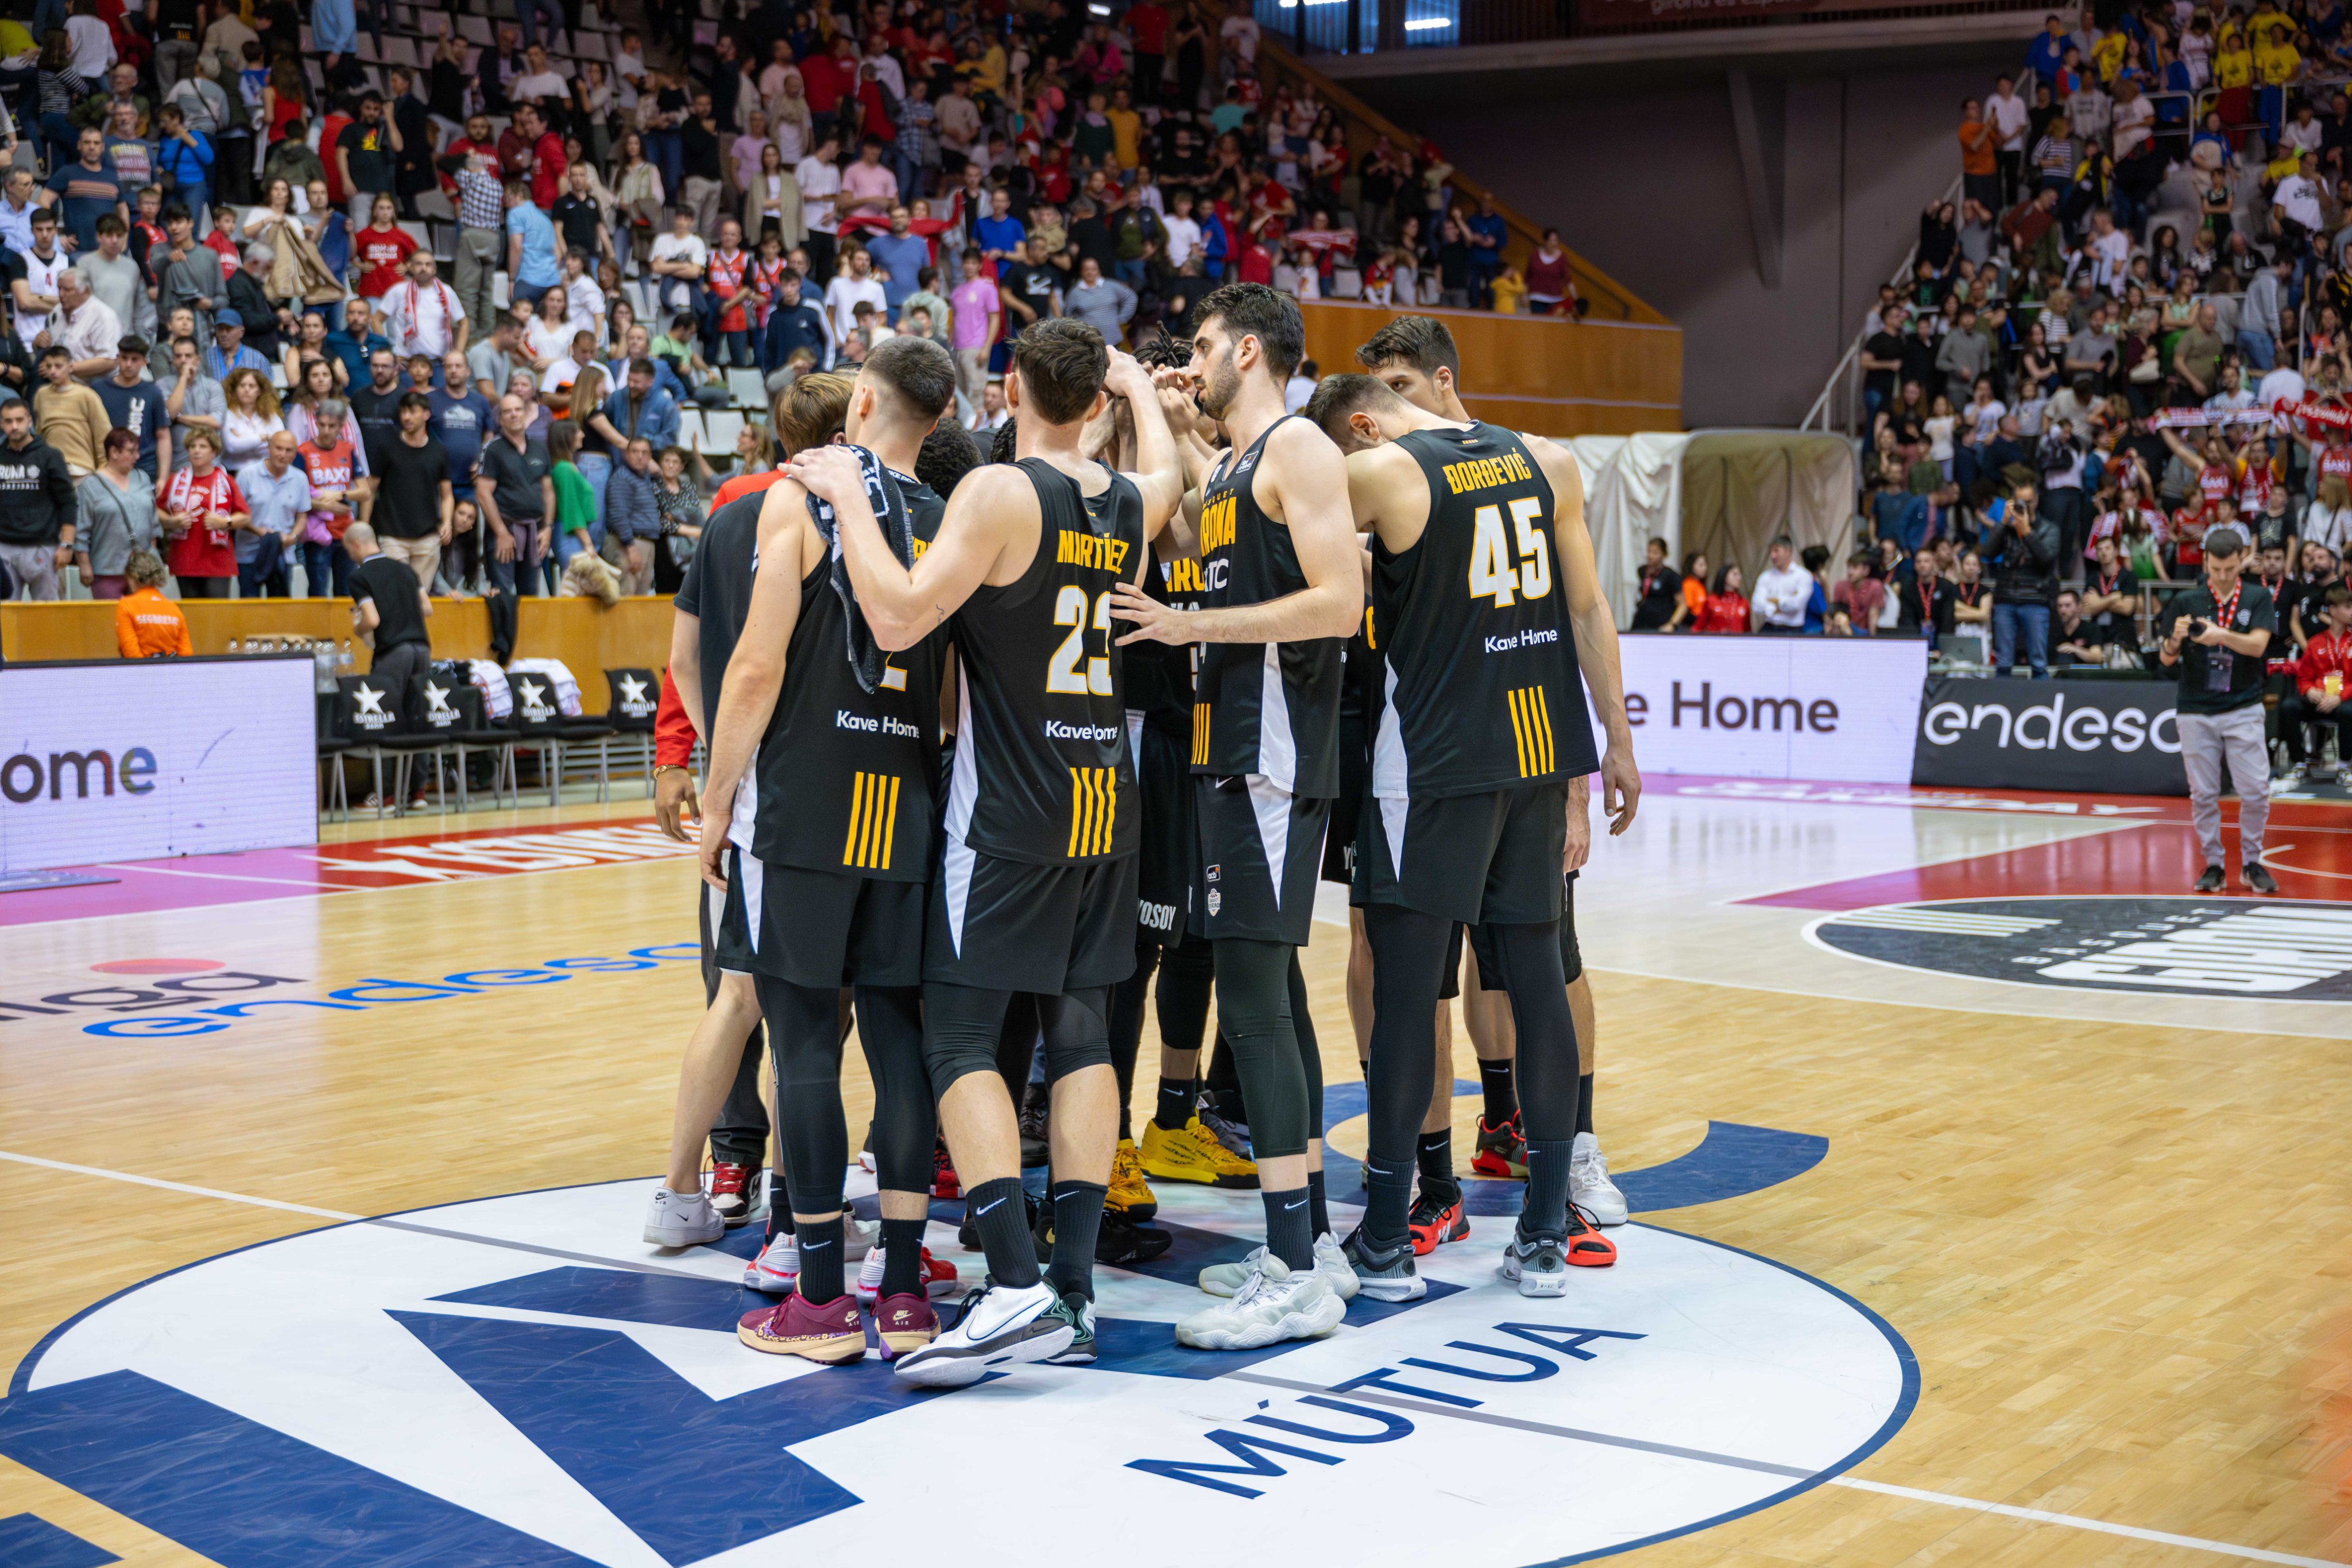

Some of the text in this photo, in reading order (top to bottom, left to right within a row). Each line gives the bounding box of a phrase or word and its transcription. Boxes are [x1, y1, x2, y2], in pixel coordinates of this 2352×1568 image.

[311, 467, 351, 485] BAXI
[1468, 496, 1552, 609] 45
[1046, 585, 1113, 696] 23
[1485, 629, 1558, 653] Kave Home
[353, 710, 396, 724] ESTRELLA
[1672, 680, 1839, 733] Home
[836, 710, 879, 733] Kave
[1046, 719, 1092, 740] Kave
[1208, 871, 1217, 880] acb
[1123, 1321, 1649, 1500] MÚTUA
